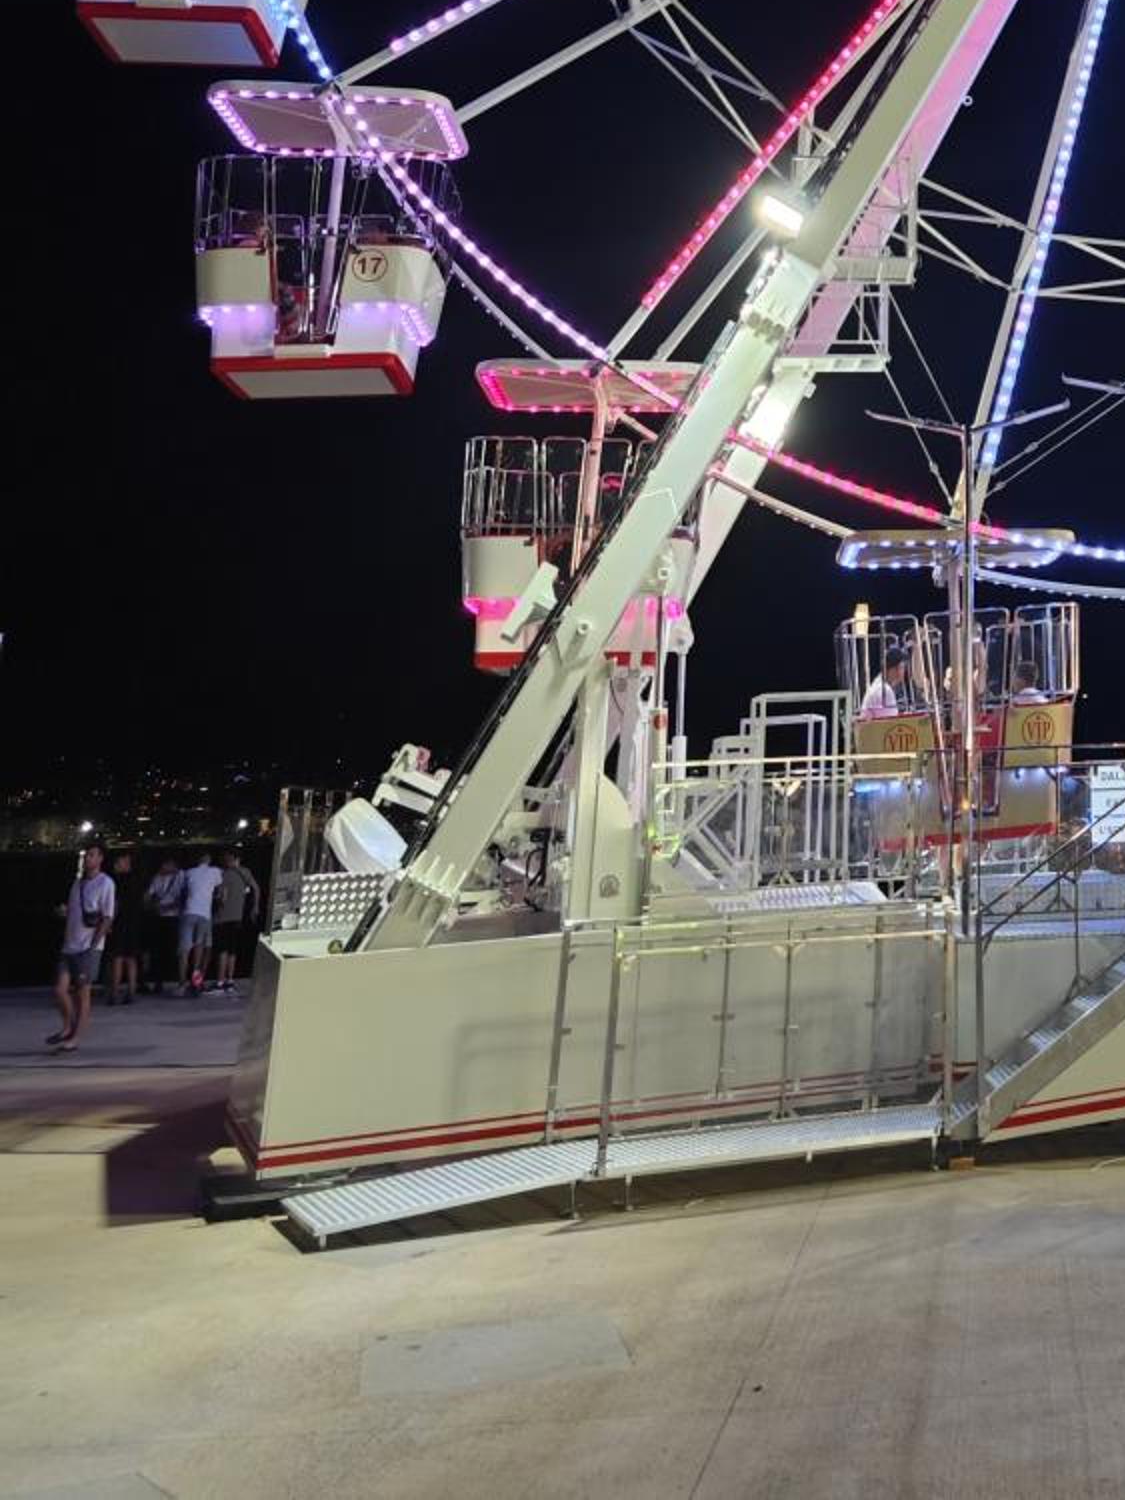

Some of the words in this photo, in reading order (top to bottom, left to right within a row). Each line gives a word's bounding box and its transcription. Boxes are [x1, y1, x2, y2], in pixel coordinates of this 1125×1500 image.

[357, 257, 383, 275] 17
[1028, 718, 1051, 744] VIP
[888, 732, 914, 752] VIP
